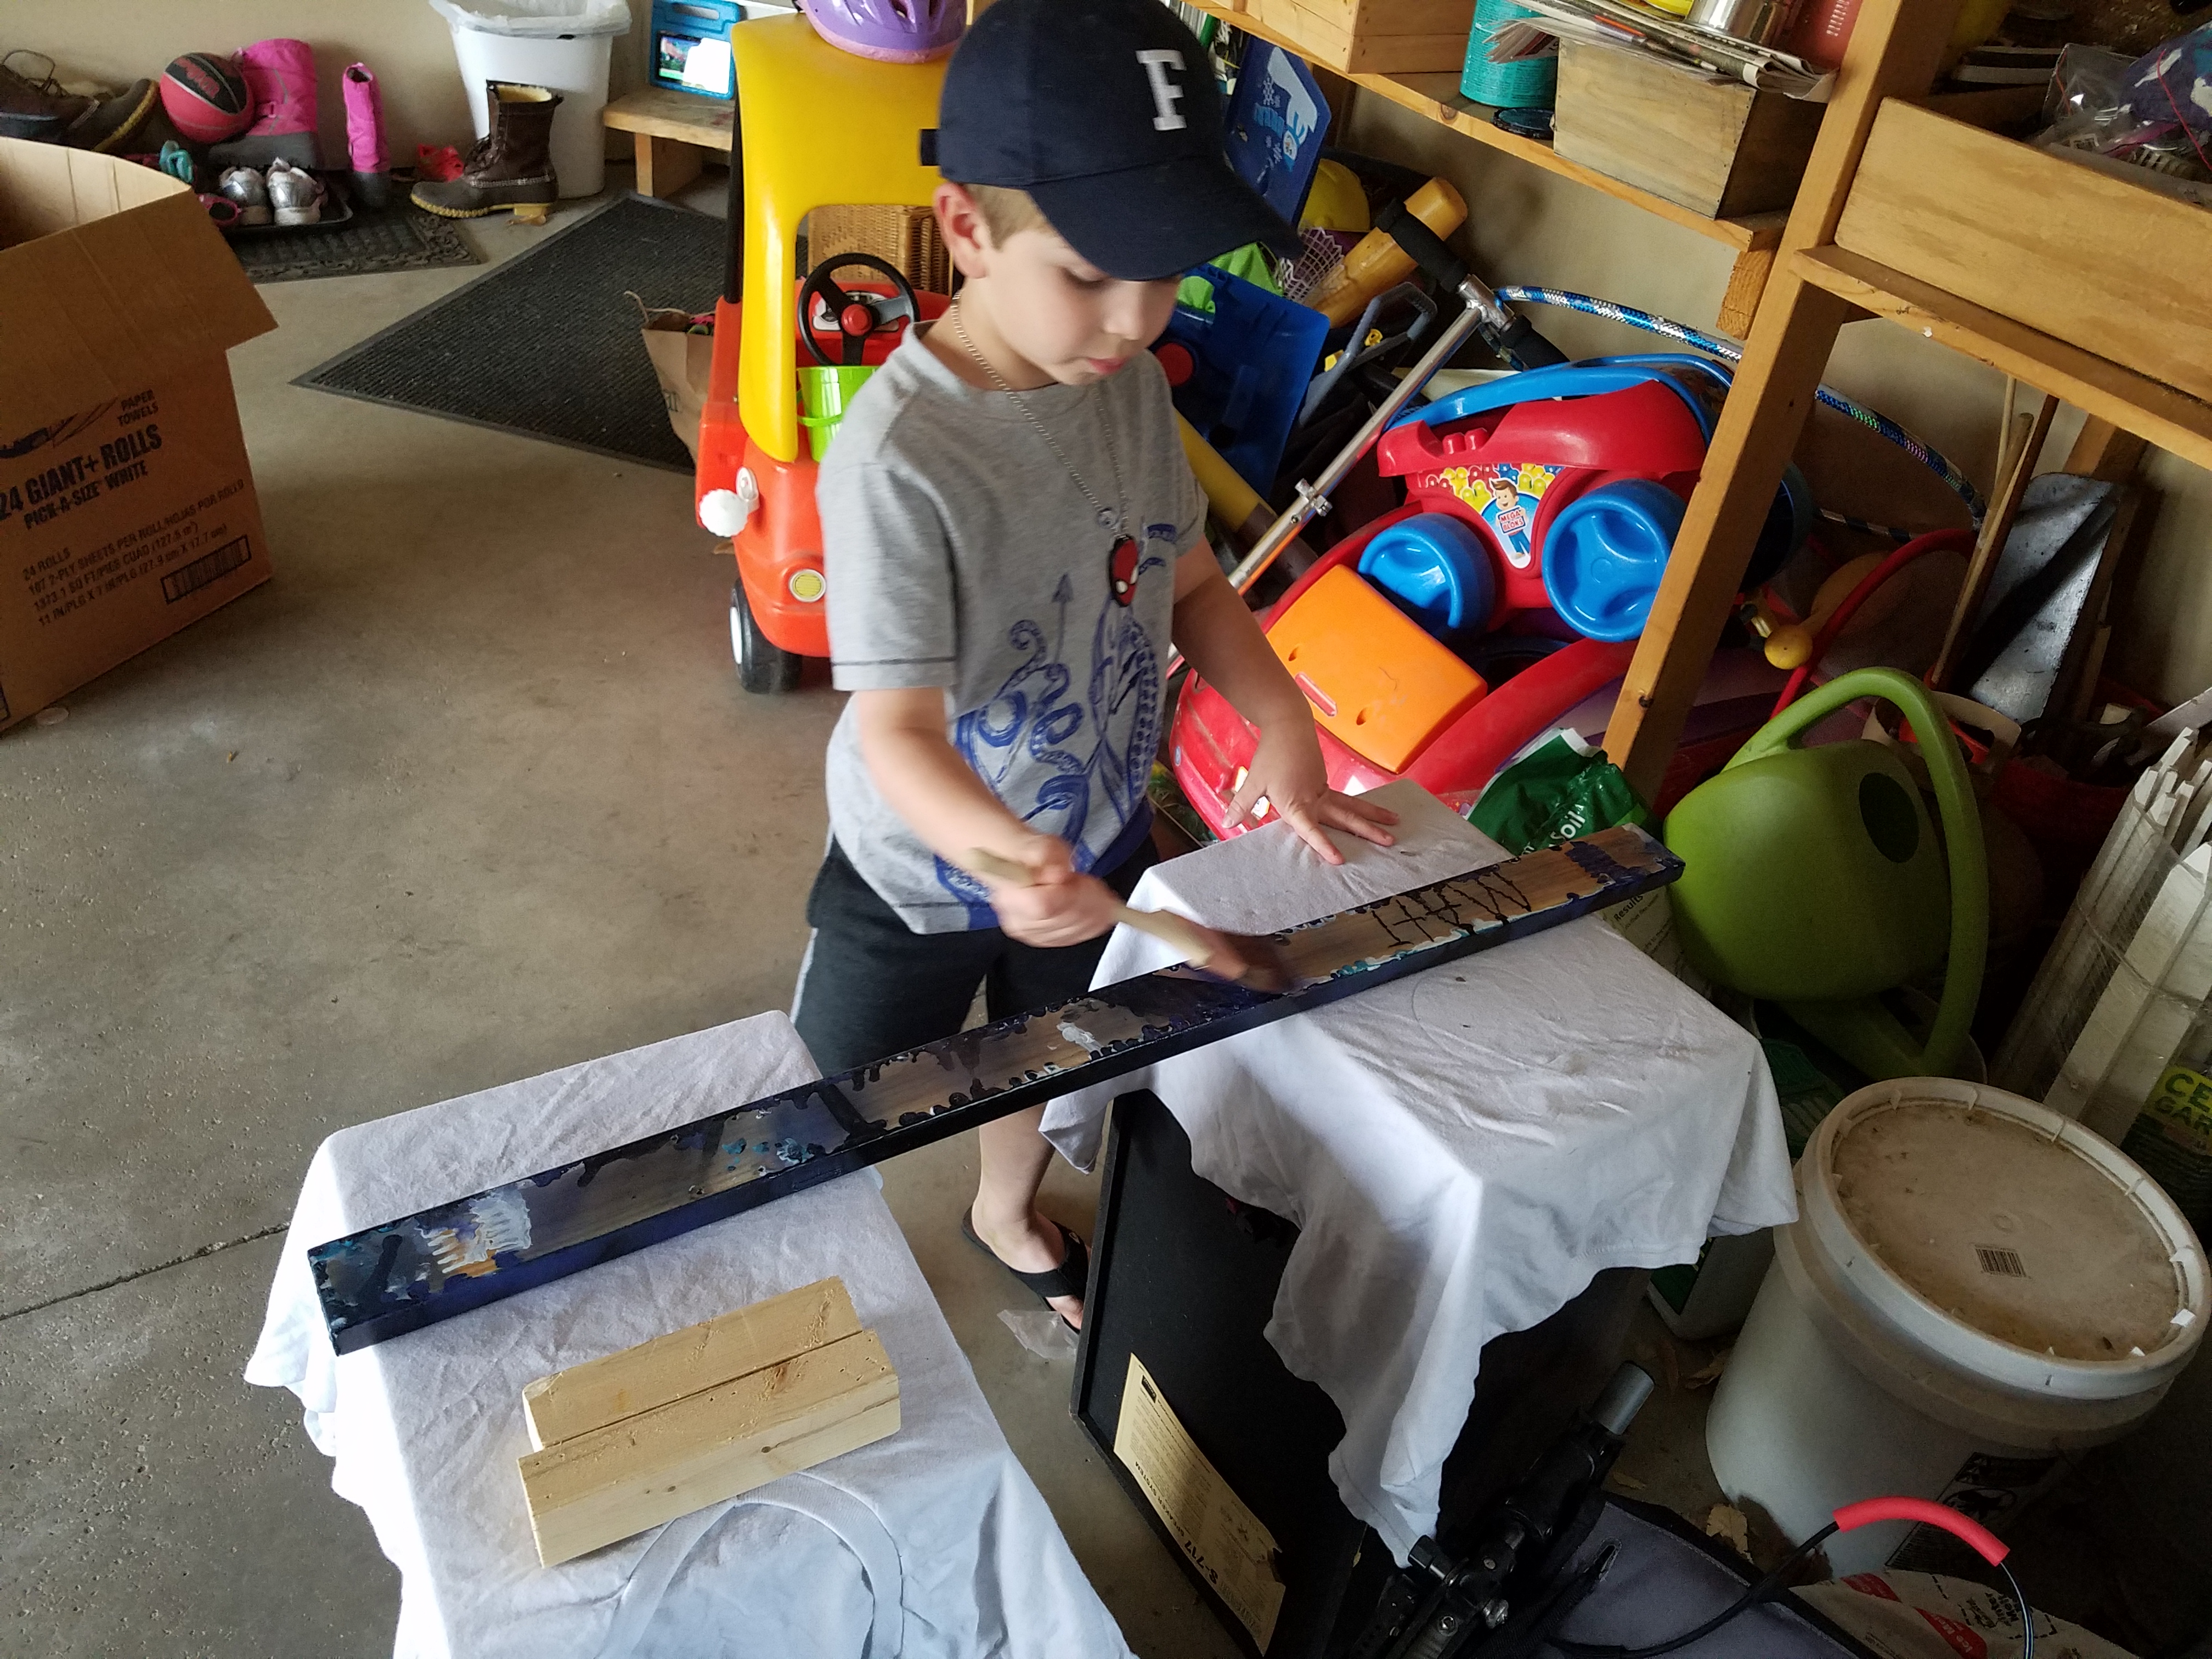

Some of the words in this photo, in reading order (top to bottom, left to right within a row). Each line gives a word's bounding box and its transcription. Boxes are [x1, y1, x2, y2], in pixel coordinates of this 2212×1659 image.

[117, 402, 159, 426] TOWELS
[121, 389, 155, 411] PAPER
[100, 424, 162, 470] ROLLS
[105, 460, 148, 490] WHITE
[1501, 510, 1521, 522] MEGA
[1503, 518, 1523, 531] BLOKS
[77, 543, 115, 569] SHEETS
[116, 533, 138, 549] PER
[198, 494, 218, 511] POR
[37, 547, 71, 572] ROLLS
[1550, 810, 1585, 842] Soil
[1613, 894, 1644, 922] Results
[1134, 1459, 1159, 1494] SYSTEM
[1154, 1493, 1185, 1536] SPEAKER
[1184, 1539, 1219, 1585] S-717
